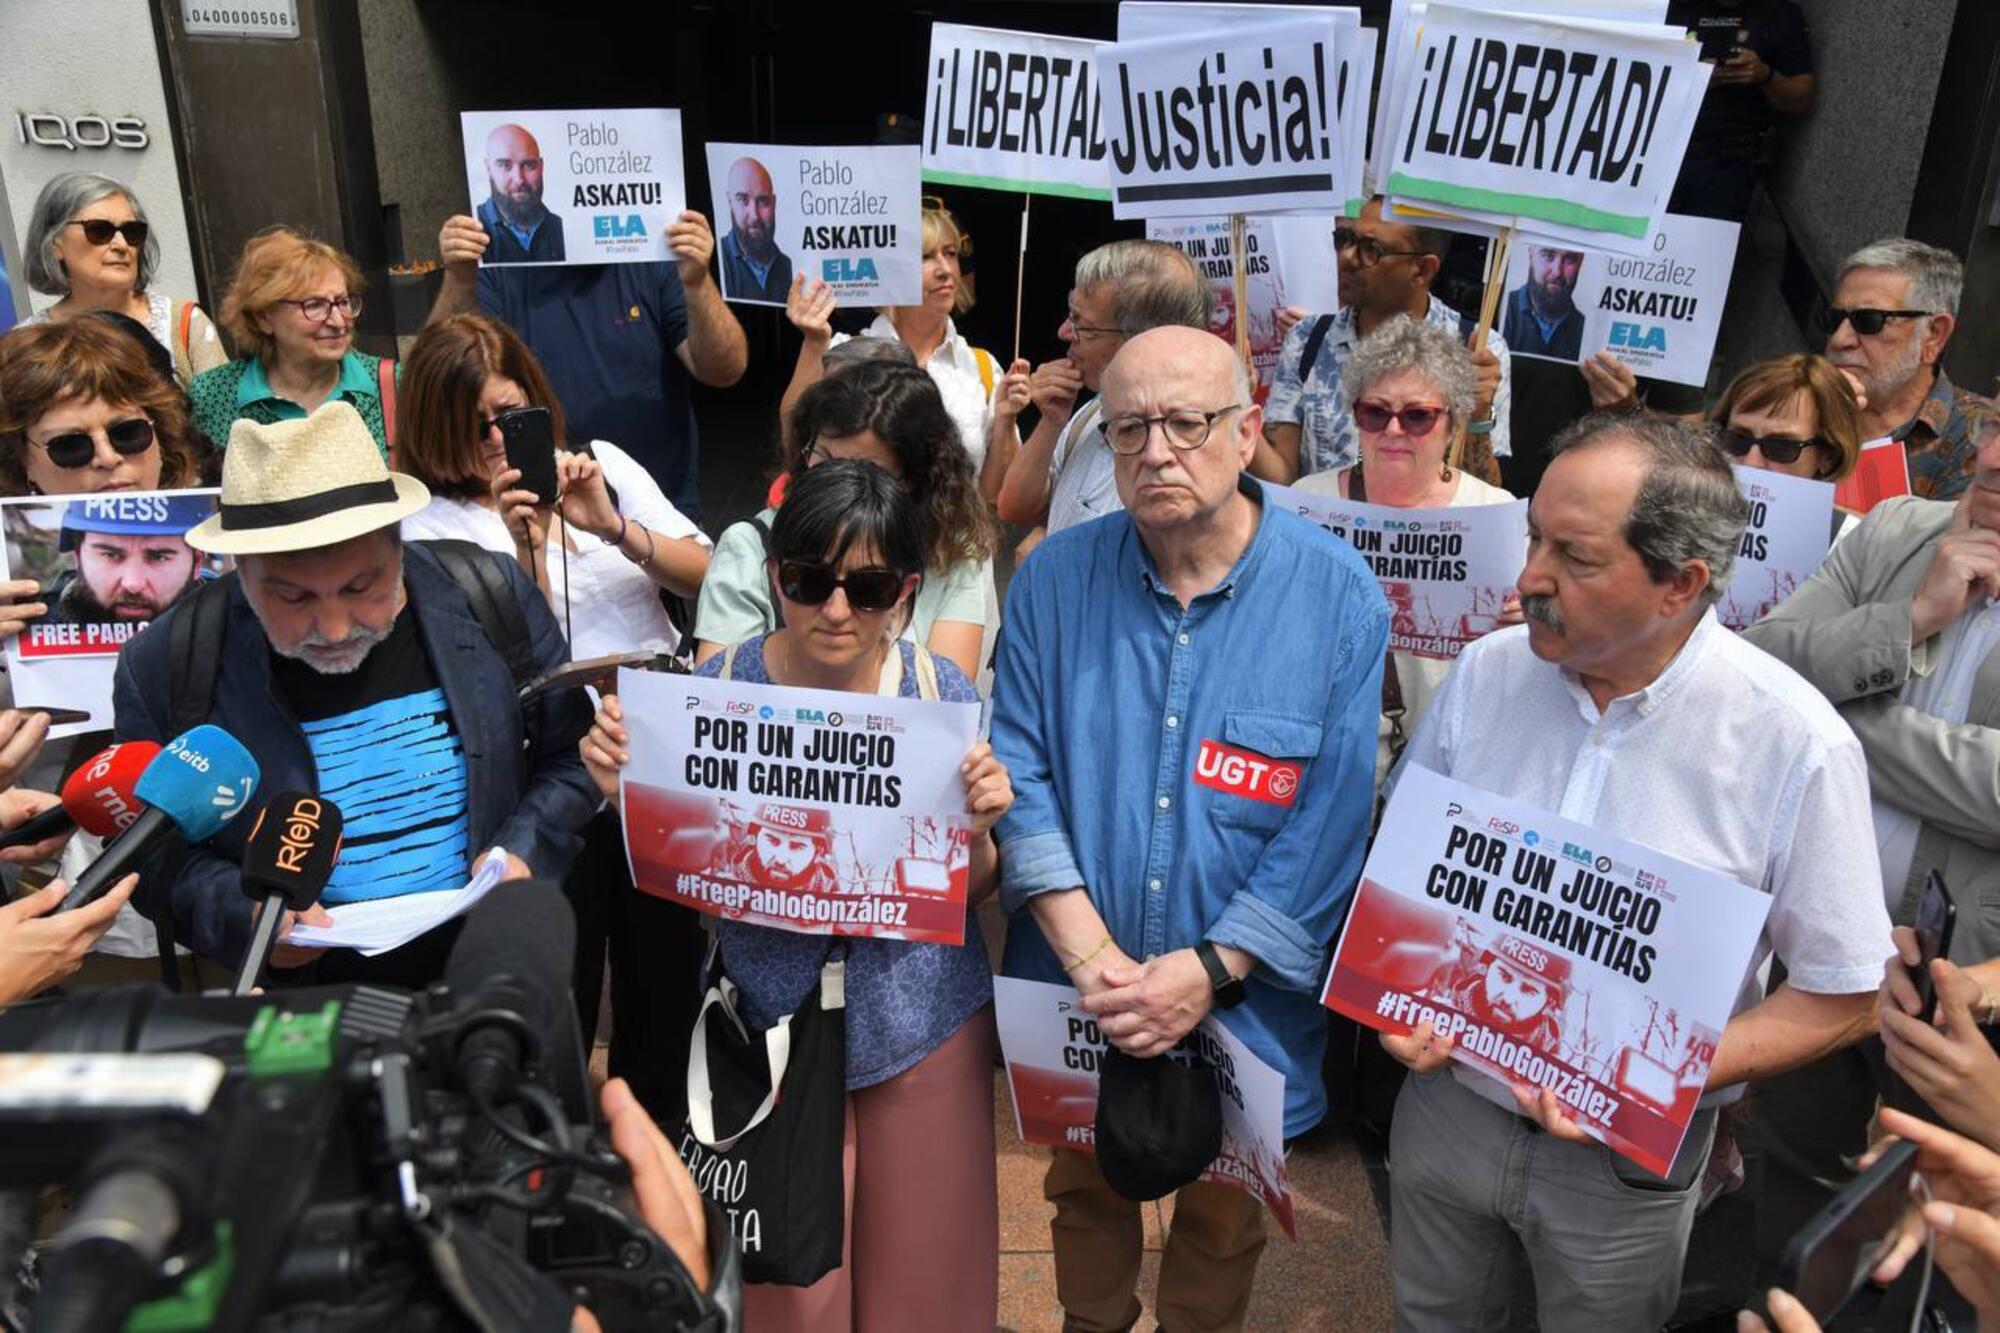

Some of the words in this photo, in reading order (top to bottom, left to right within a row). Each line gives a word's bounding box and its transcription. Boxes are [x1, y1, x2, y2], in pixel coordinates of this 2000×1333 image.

[192, 9, 288, 26] 0400000506
[1111, 42, 1331, 175] Justicia!
[1403, 35, 1672, 187] ¡LIBERTAD!
[15, 113, 149, 150] IQOS
[567, 122, 618, 146] Pablo
[569, 150, 652, 175] González
[800, 159, 852, 185] Pablo
[573, 182, 662, 207] ASKATU!
[801, 190, 888, 215] González
[593, 214, 647, 237] ELA
[802, 224, 897, 250] ASKATU!
[1188, 239, 1207, 258] UN
[1212, 234, 1258, 257] JUO
[822, 257, 879, 281] ELA
[1199, 254, 1270, 279] ARANAS
[1607, 257, 1697, 286] González
[1599, 286, 1698, 321] ASKATU!
[1609, 321, 1667, 352] ELA
[85, 495, 169, 523] PRESS
[1353, 528, 1382, 552] UN
[1390, 533, 1462, 557] JUICIO
[1363, 555, 1467, 582] RANTÍAS
[31, 623, 82, 647] FREE
[86, 621, 150, 645] PAB
[795, 708, 825, 722] ELA
[694, 715, 748, 754] POR
[757, 723, 795, 759] UN
[803, 729, 895, 768] JUICIO
[179, 747, 210, 773] eitb
[1197, 746, 1270, 791] UGT
[685, 754, 739, 792] CON
[748, 762, 902, 808] GARANTÍAS
[94, 786, 138, 828] rne
[762, 803, 809, 828] PRESS
[1445, 825, 1507, 876] POR
[1512, 847, 1556, 894] UN
[1560, 868, 1662, 936] JUICIO
[676, 873, 908, 926] #FreePabloGonzález
[1426, 863, 1488, 914] CON
[1492, 887, 1657, 984] GARANTÍAS
[1500, 937, 1549, 973] PRESS
[1376, 991, 1620, 1127] #FreePabloGonzález
